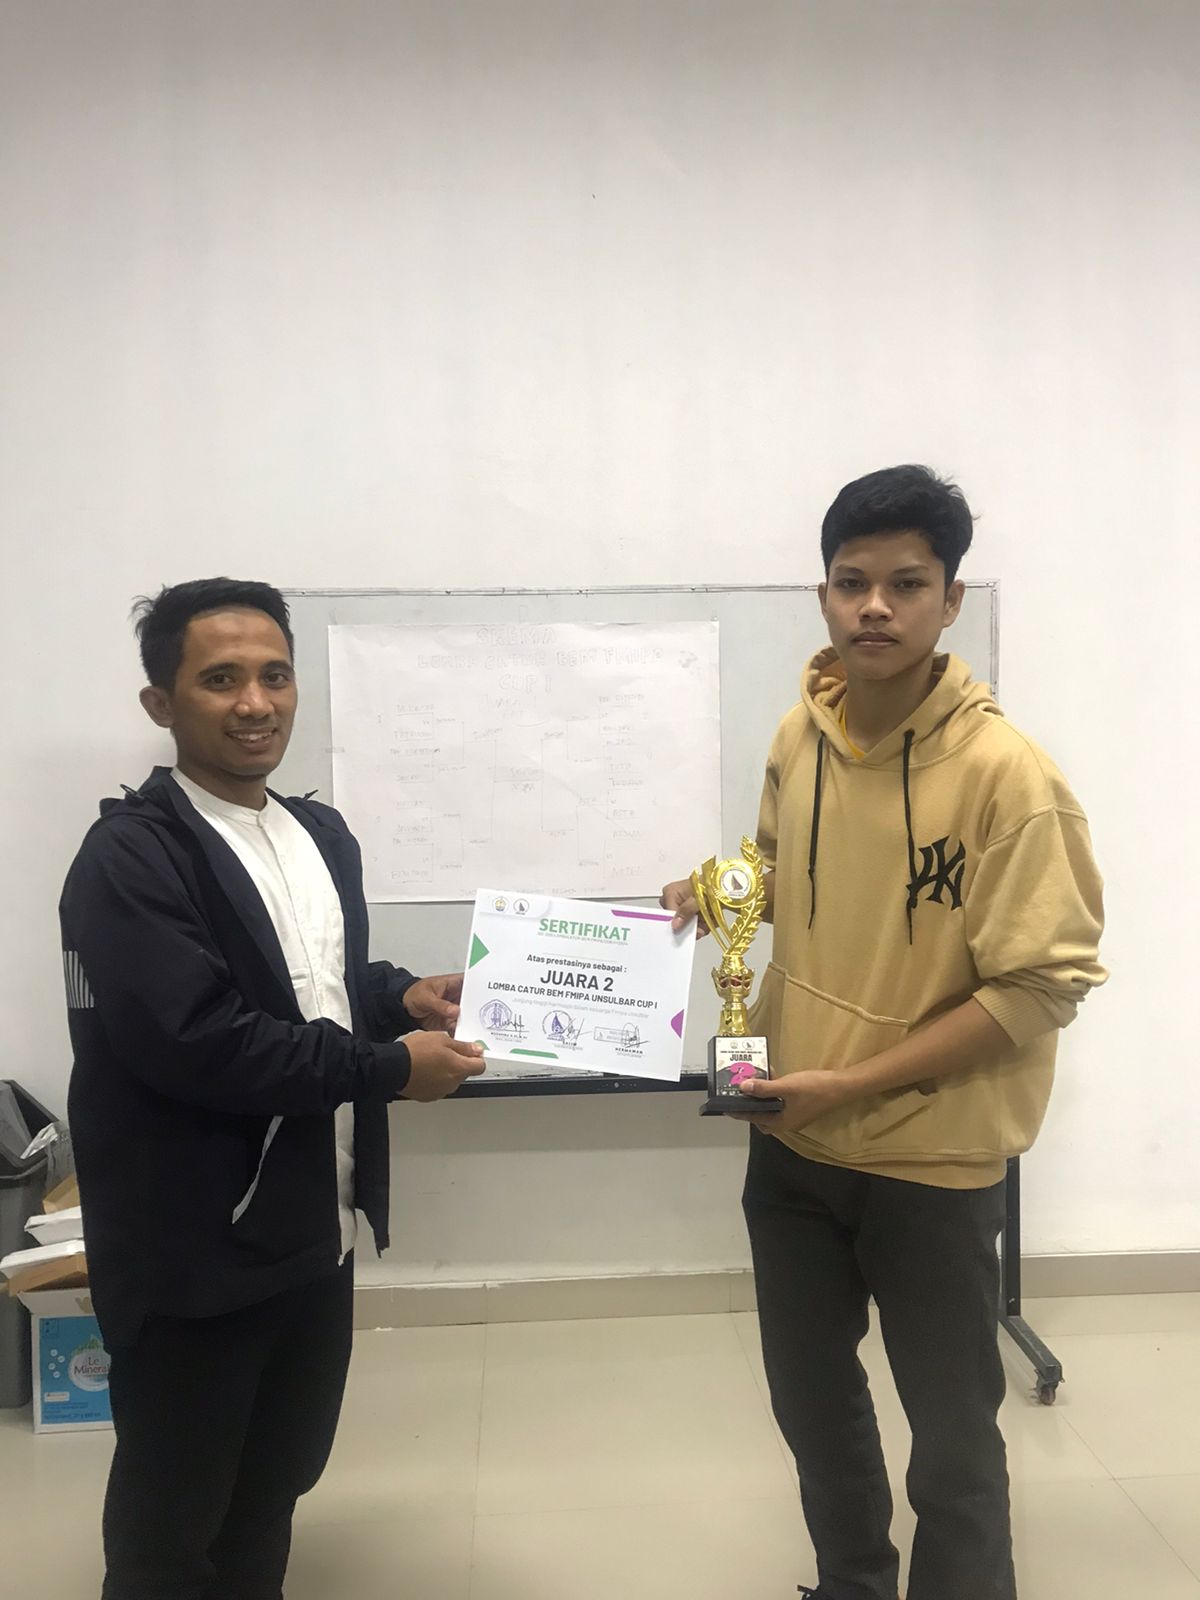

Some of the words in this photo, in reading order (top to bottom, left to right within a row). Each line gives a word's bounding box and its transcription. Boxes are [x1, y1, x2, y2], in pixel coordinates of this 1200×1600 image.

[538, 918, 631, 941] SERTIFIKAT
[526, 954, 545, 963] Atas
[546, 957, 592, 970] prestasinya
[592, 963, 623, 973] sebagai
[540, 970, 599, 990] JUARA
[604, 977, 614, 992] 2
[488, 982, 517, 993] LOMBA
[517, 985, 545, 995] CATUR
[546, 988, 564, 998] BEM
[565, 991, 590, 1001] FMIPA
[591, 994, 636, 1006] UNSULBAR
[636, 999, 654, 1009] CUP
[730, 1053, 753, 1062] JUARA
[88, 1357, 99, 1366] Le
